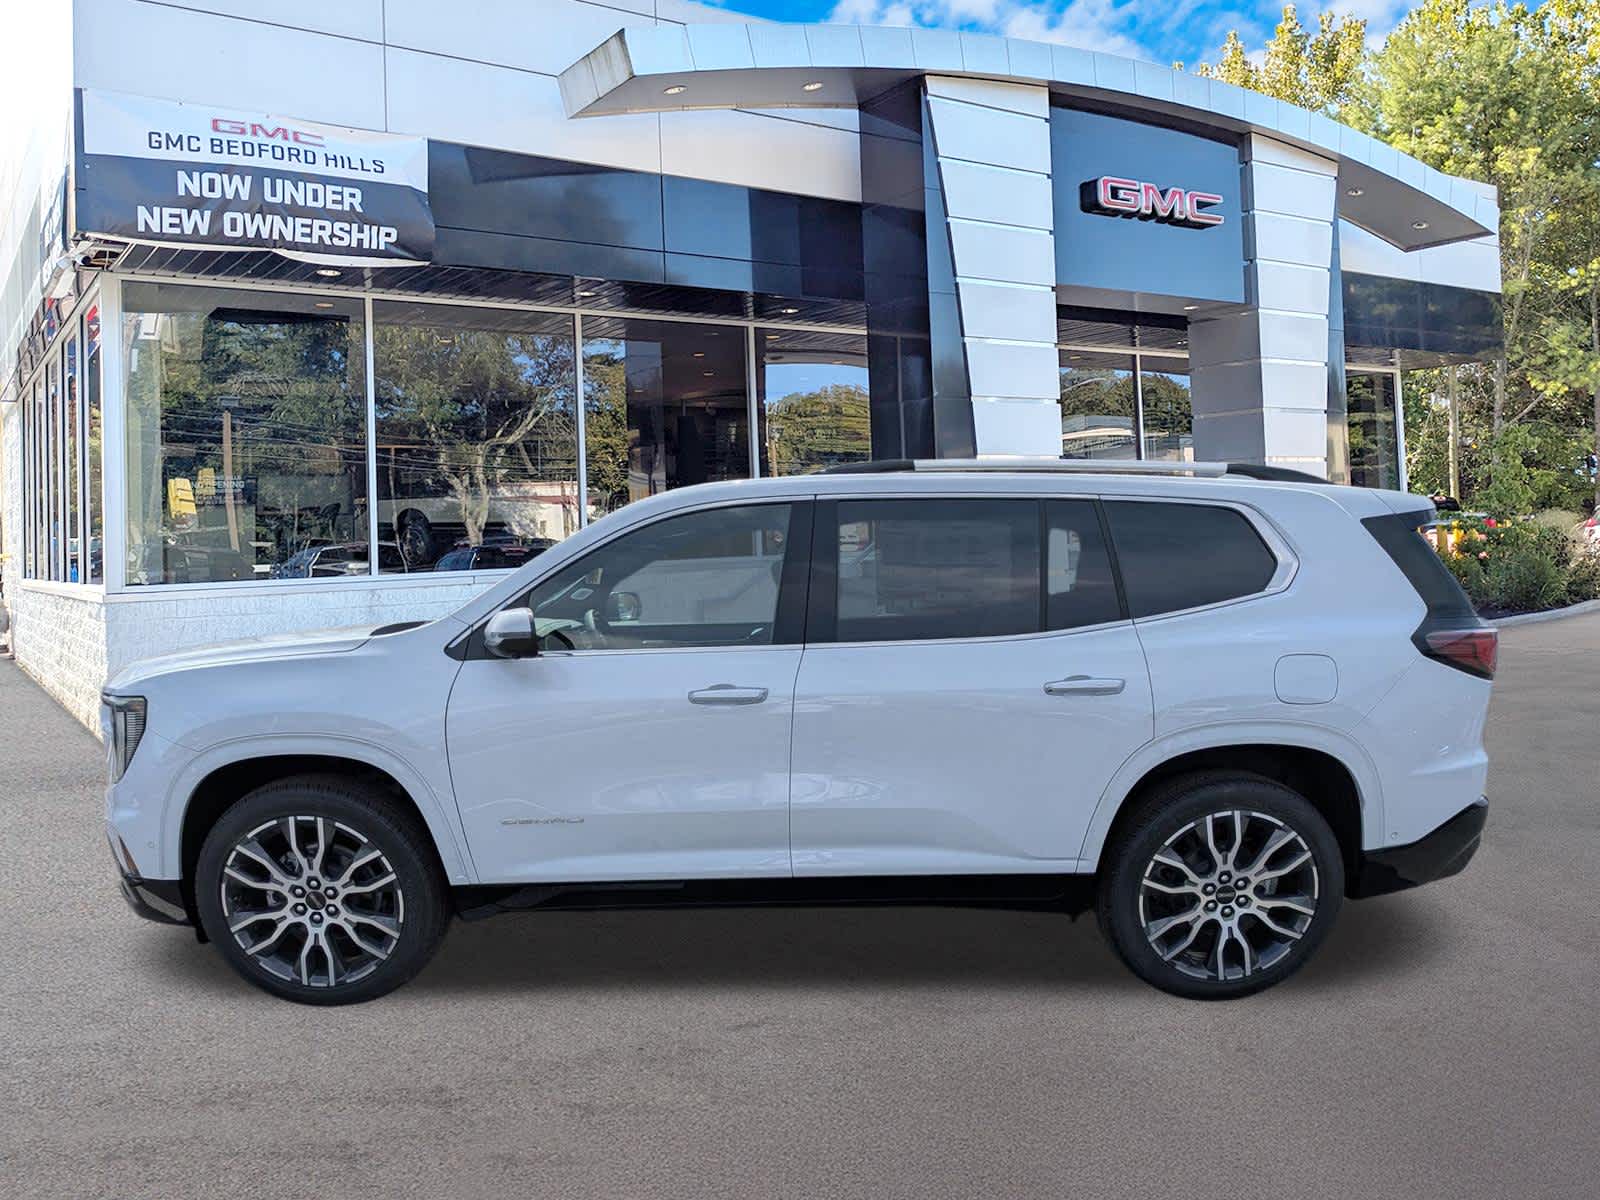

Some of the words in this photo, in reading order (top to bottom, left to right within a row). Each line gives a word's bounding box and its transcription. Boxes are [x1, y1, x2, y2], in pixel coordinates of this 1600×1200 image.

[148, 131, 201, 152] GMC
[210, 139, 317, 165] BEDFORD
[325, 153, 385, 174] HILLS
[211, 118, 326, 148] GMC
[177, 170, 252, 201] NOW
[263, 177, 364, 213] UNDER
[1097, 175, 1225, 225] GMC
[137, 206, 212, 236] NEW
[223, 210, 398, 250] OWNERSHIP
